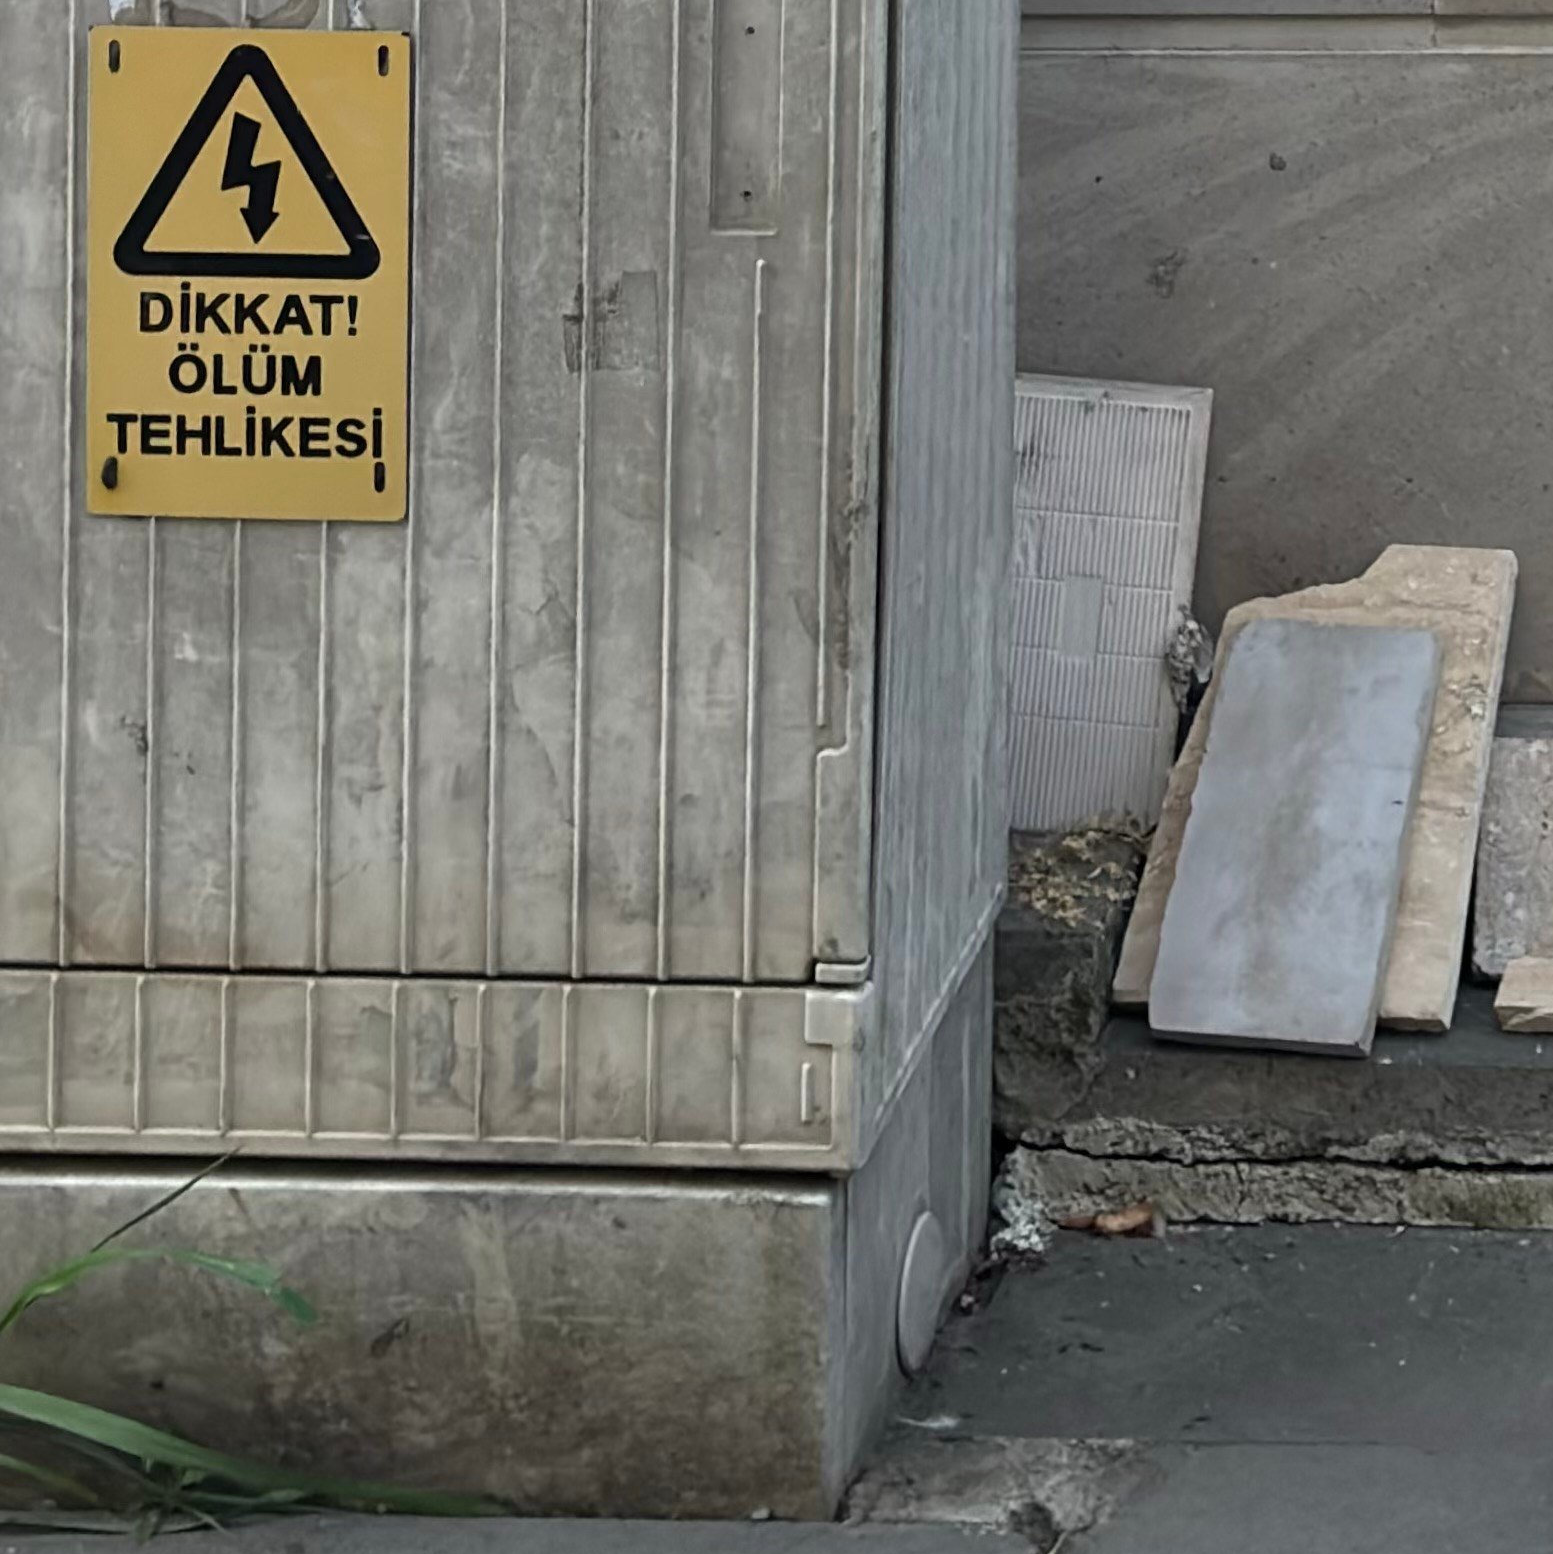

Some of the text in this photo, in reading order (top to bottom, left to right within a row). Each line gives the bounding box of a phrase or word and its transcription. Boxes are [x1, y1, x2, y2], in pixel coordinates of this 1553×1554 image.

[139, 281, 358, 336] DİKKAT!
[168, 342, 322, 396] ÖLÜM
[106, 405, 383, 458] TEHLİKESİ
